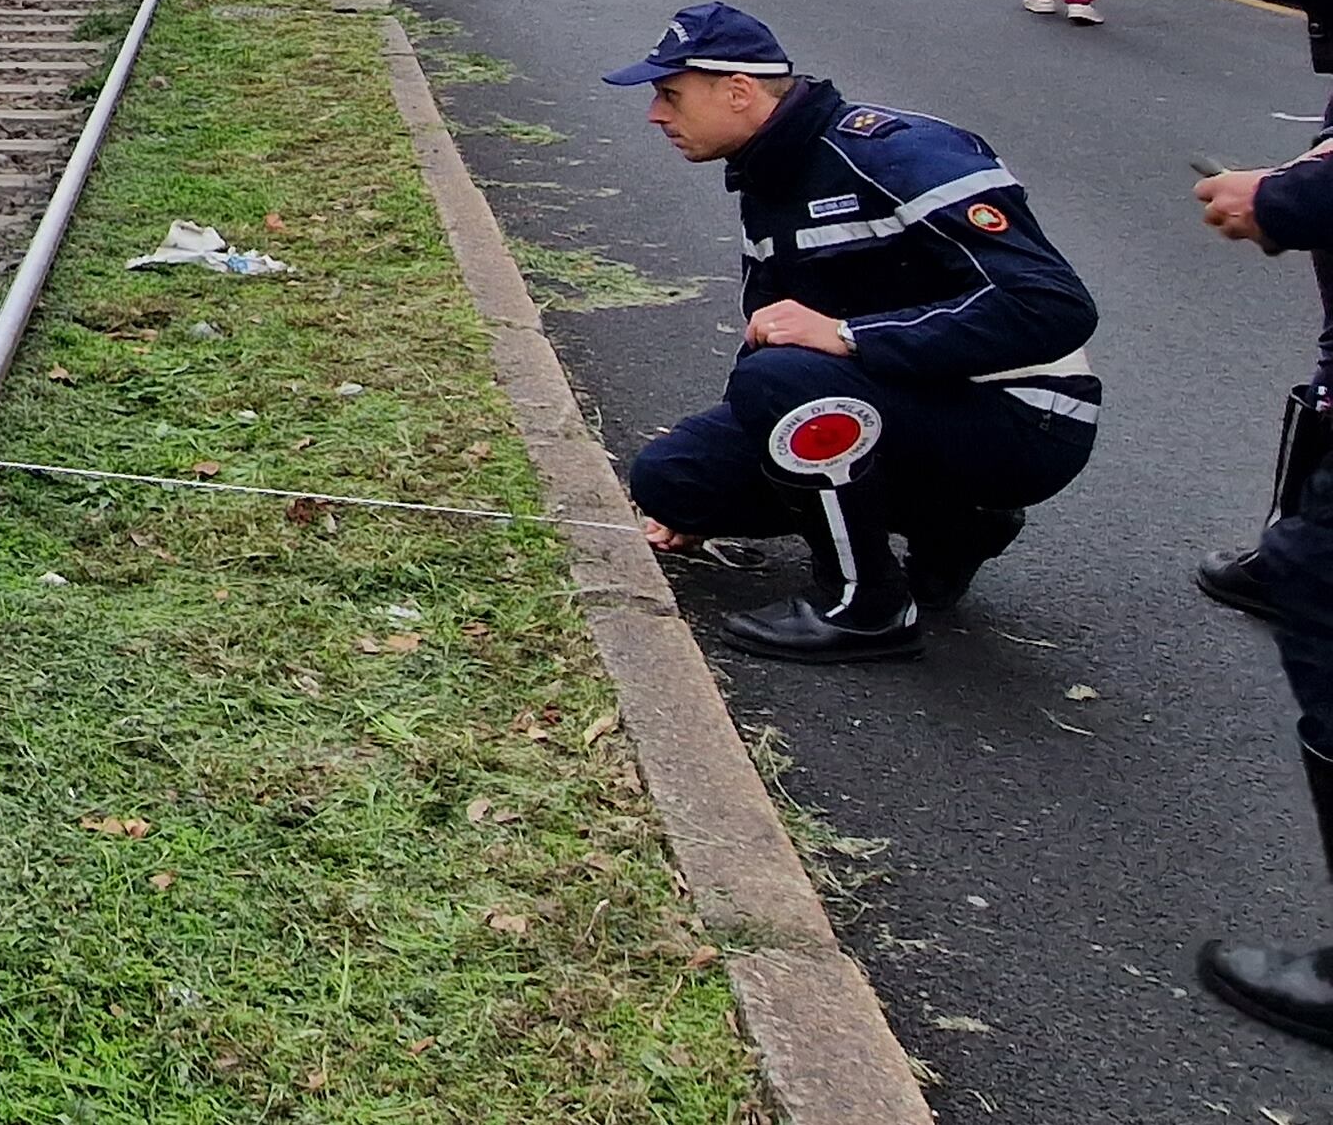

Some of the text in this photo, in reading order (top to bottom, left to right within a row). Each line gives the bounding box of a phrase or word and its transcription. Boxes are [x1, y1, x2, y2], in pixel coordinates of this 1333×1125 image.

[777, 403, 875, 456] COMUNE DI MILANO
